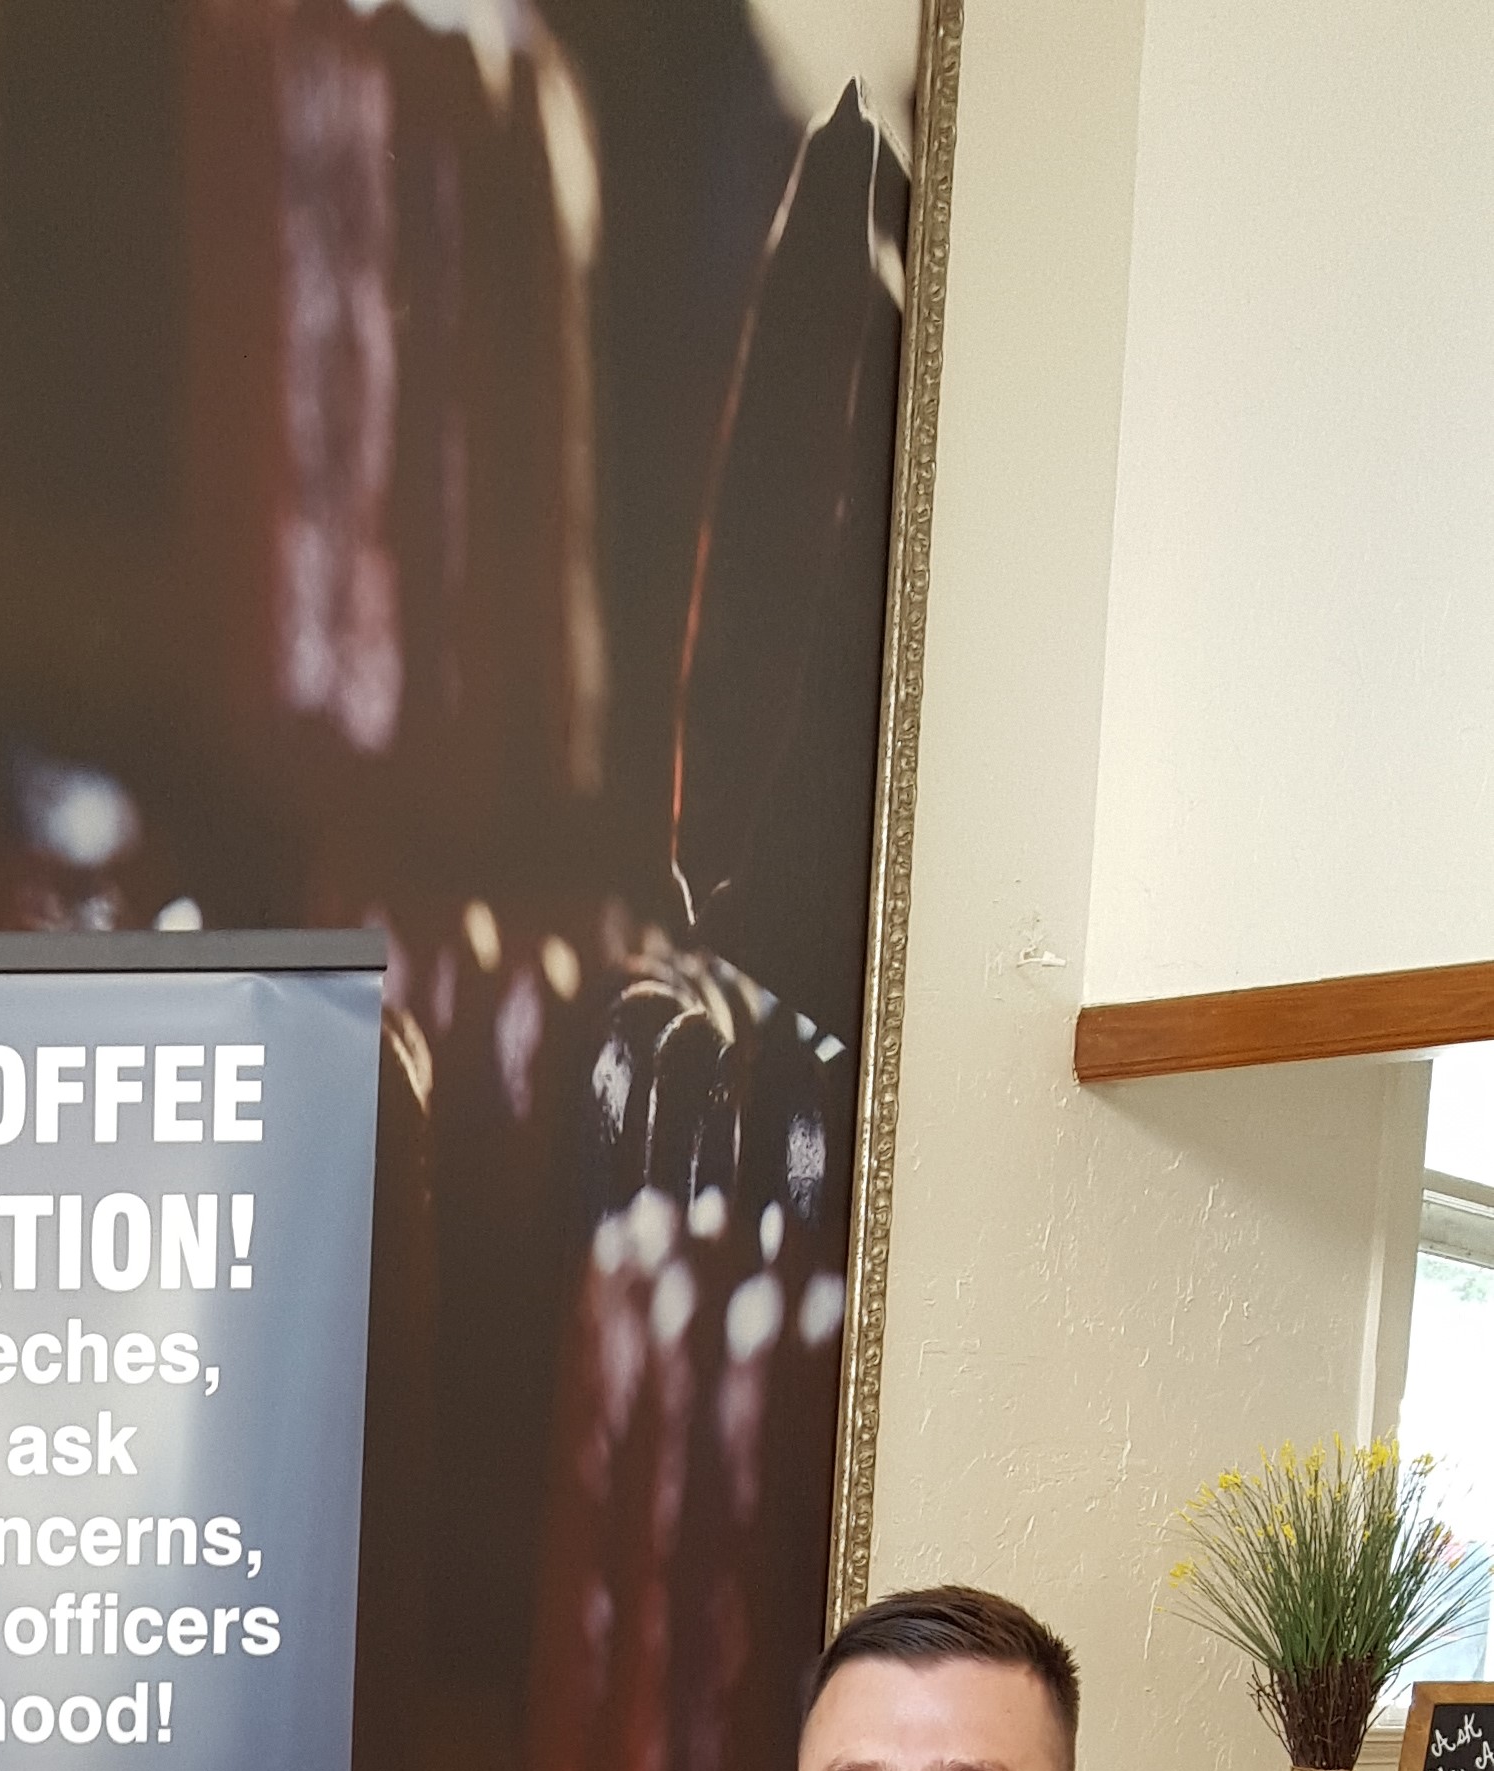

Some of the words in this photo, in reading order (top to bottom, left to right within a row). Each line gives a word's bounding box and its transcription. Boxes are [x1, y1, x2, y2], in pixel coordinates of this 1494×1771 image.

[8, 1411, 137, 1475] ask
[4, 1589, 280, 1656] officers
[1431, 1712, 1482, 1757] Ask
